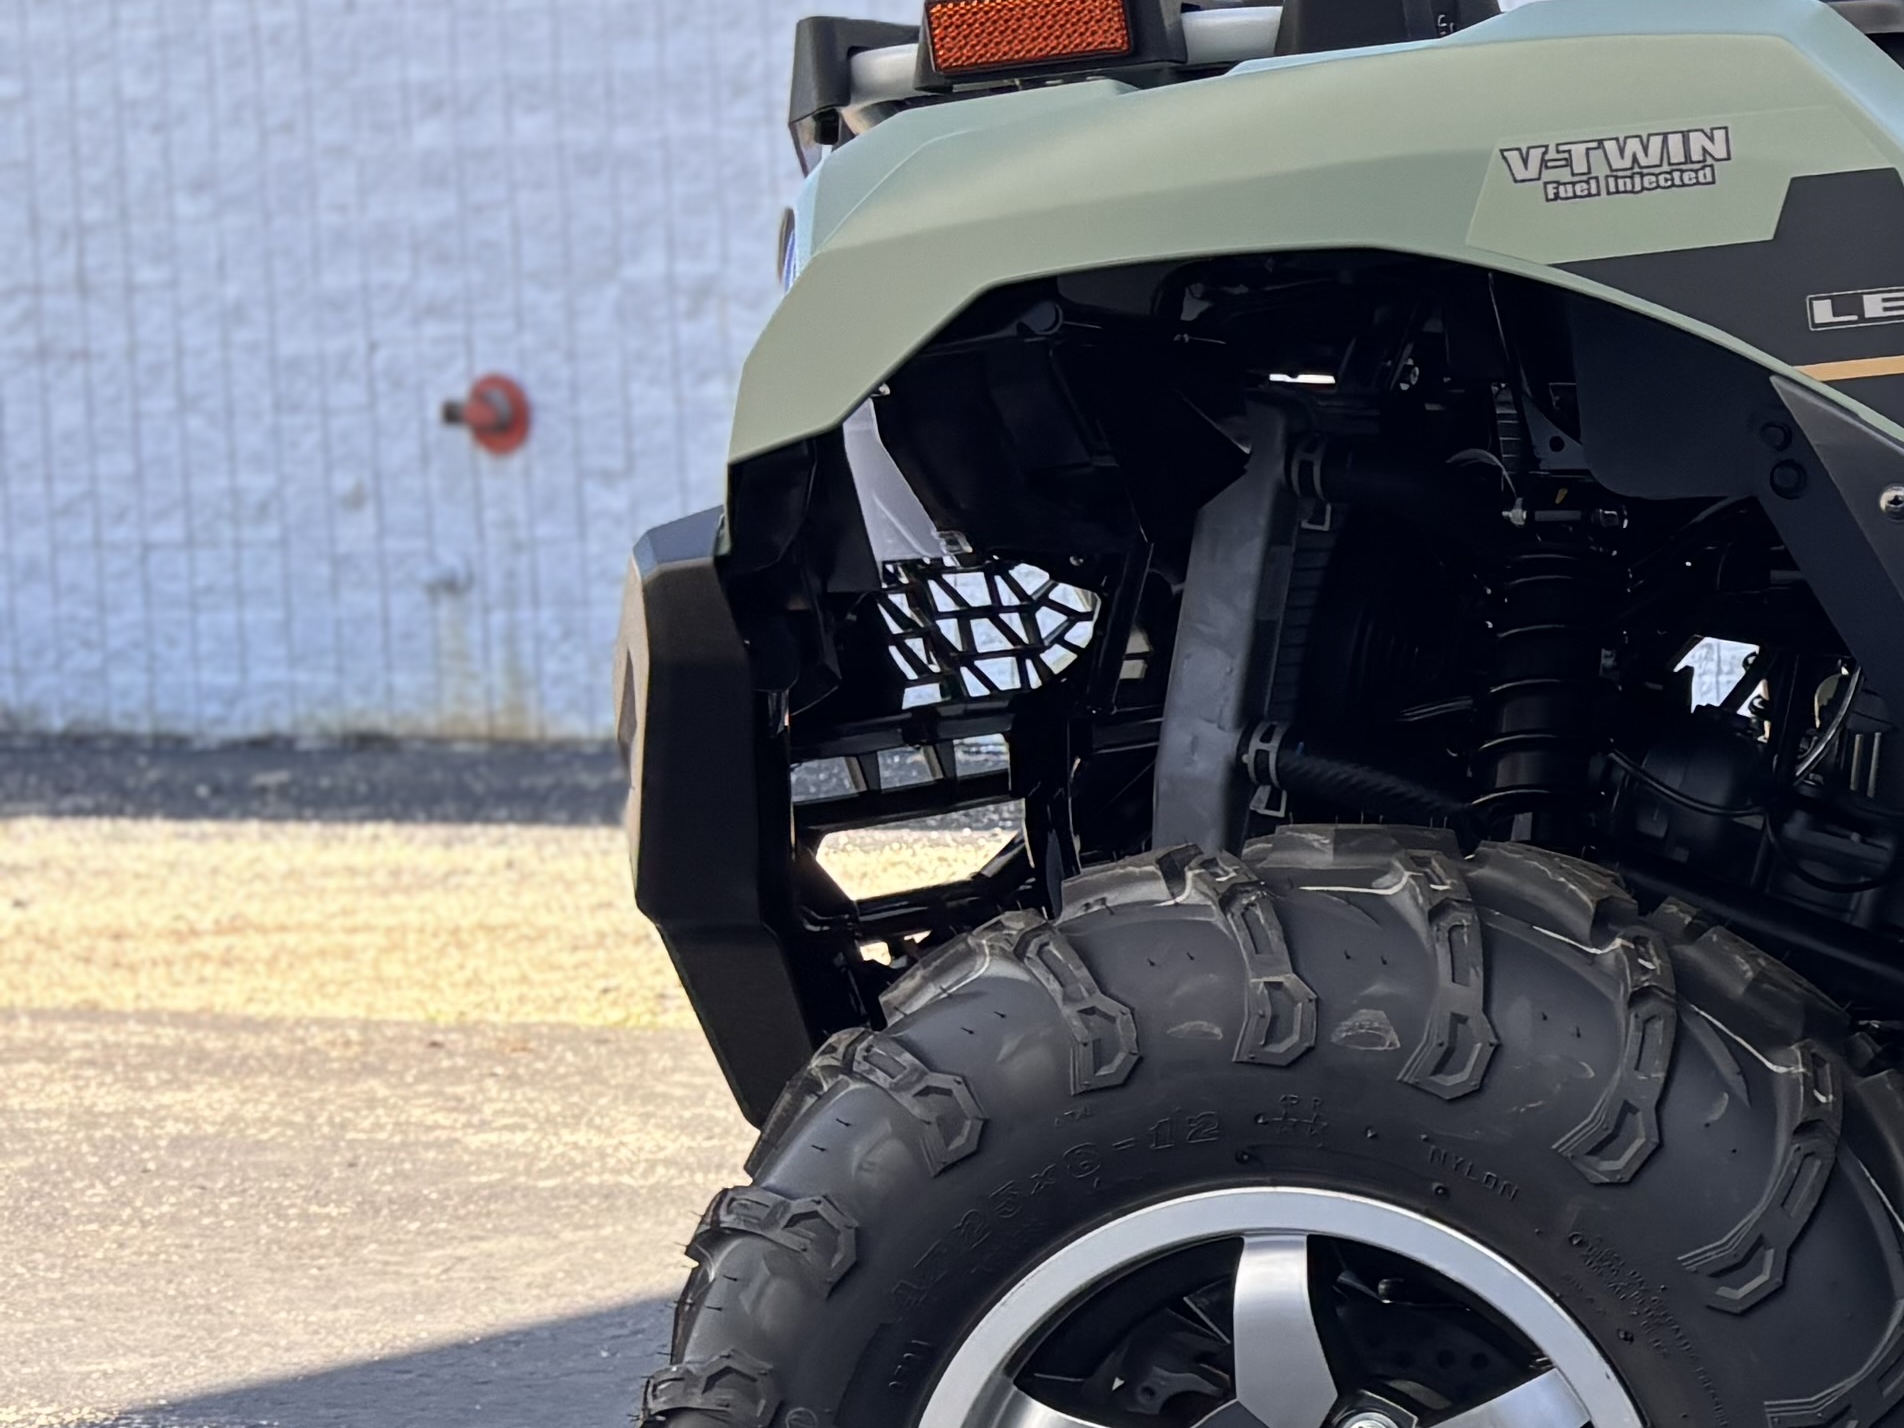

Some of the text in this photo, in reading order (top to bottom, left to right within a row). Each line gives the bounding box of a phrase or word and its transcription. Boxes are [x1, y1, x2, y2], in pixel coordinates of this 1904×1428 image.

[1500, 126, 1731, 183] V-TWIN
[1543, 164, 1716, 202] Fuel Injected
[1425, 1146, 1522, 1204] NYLON
